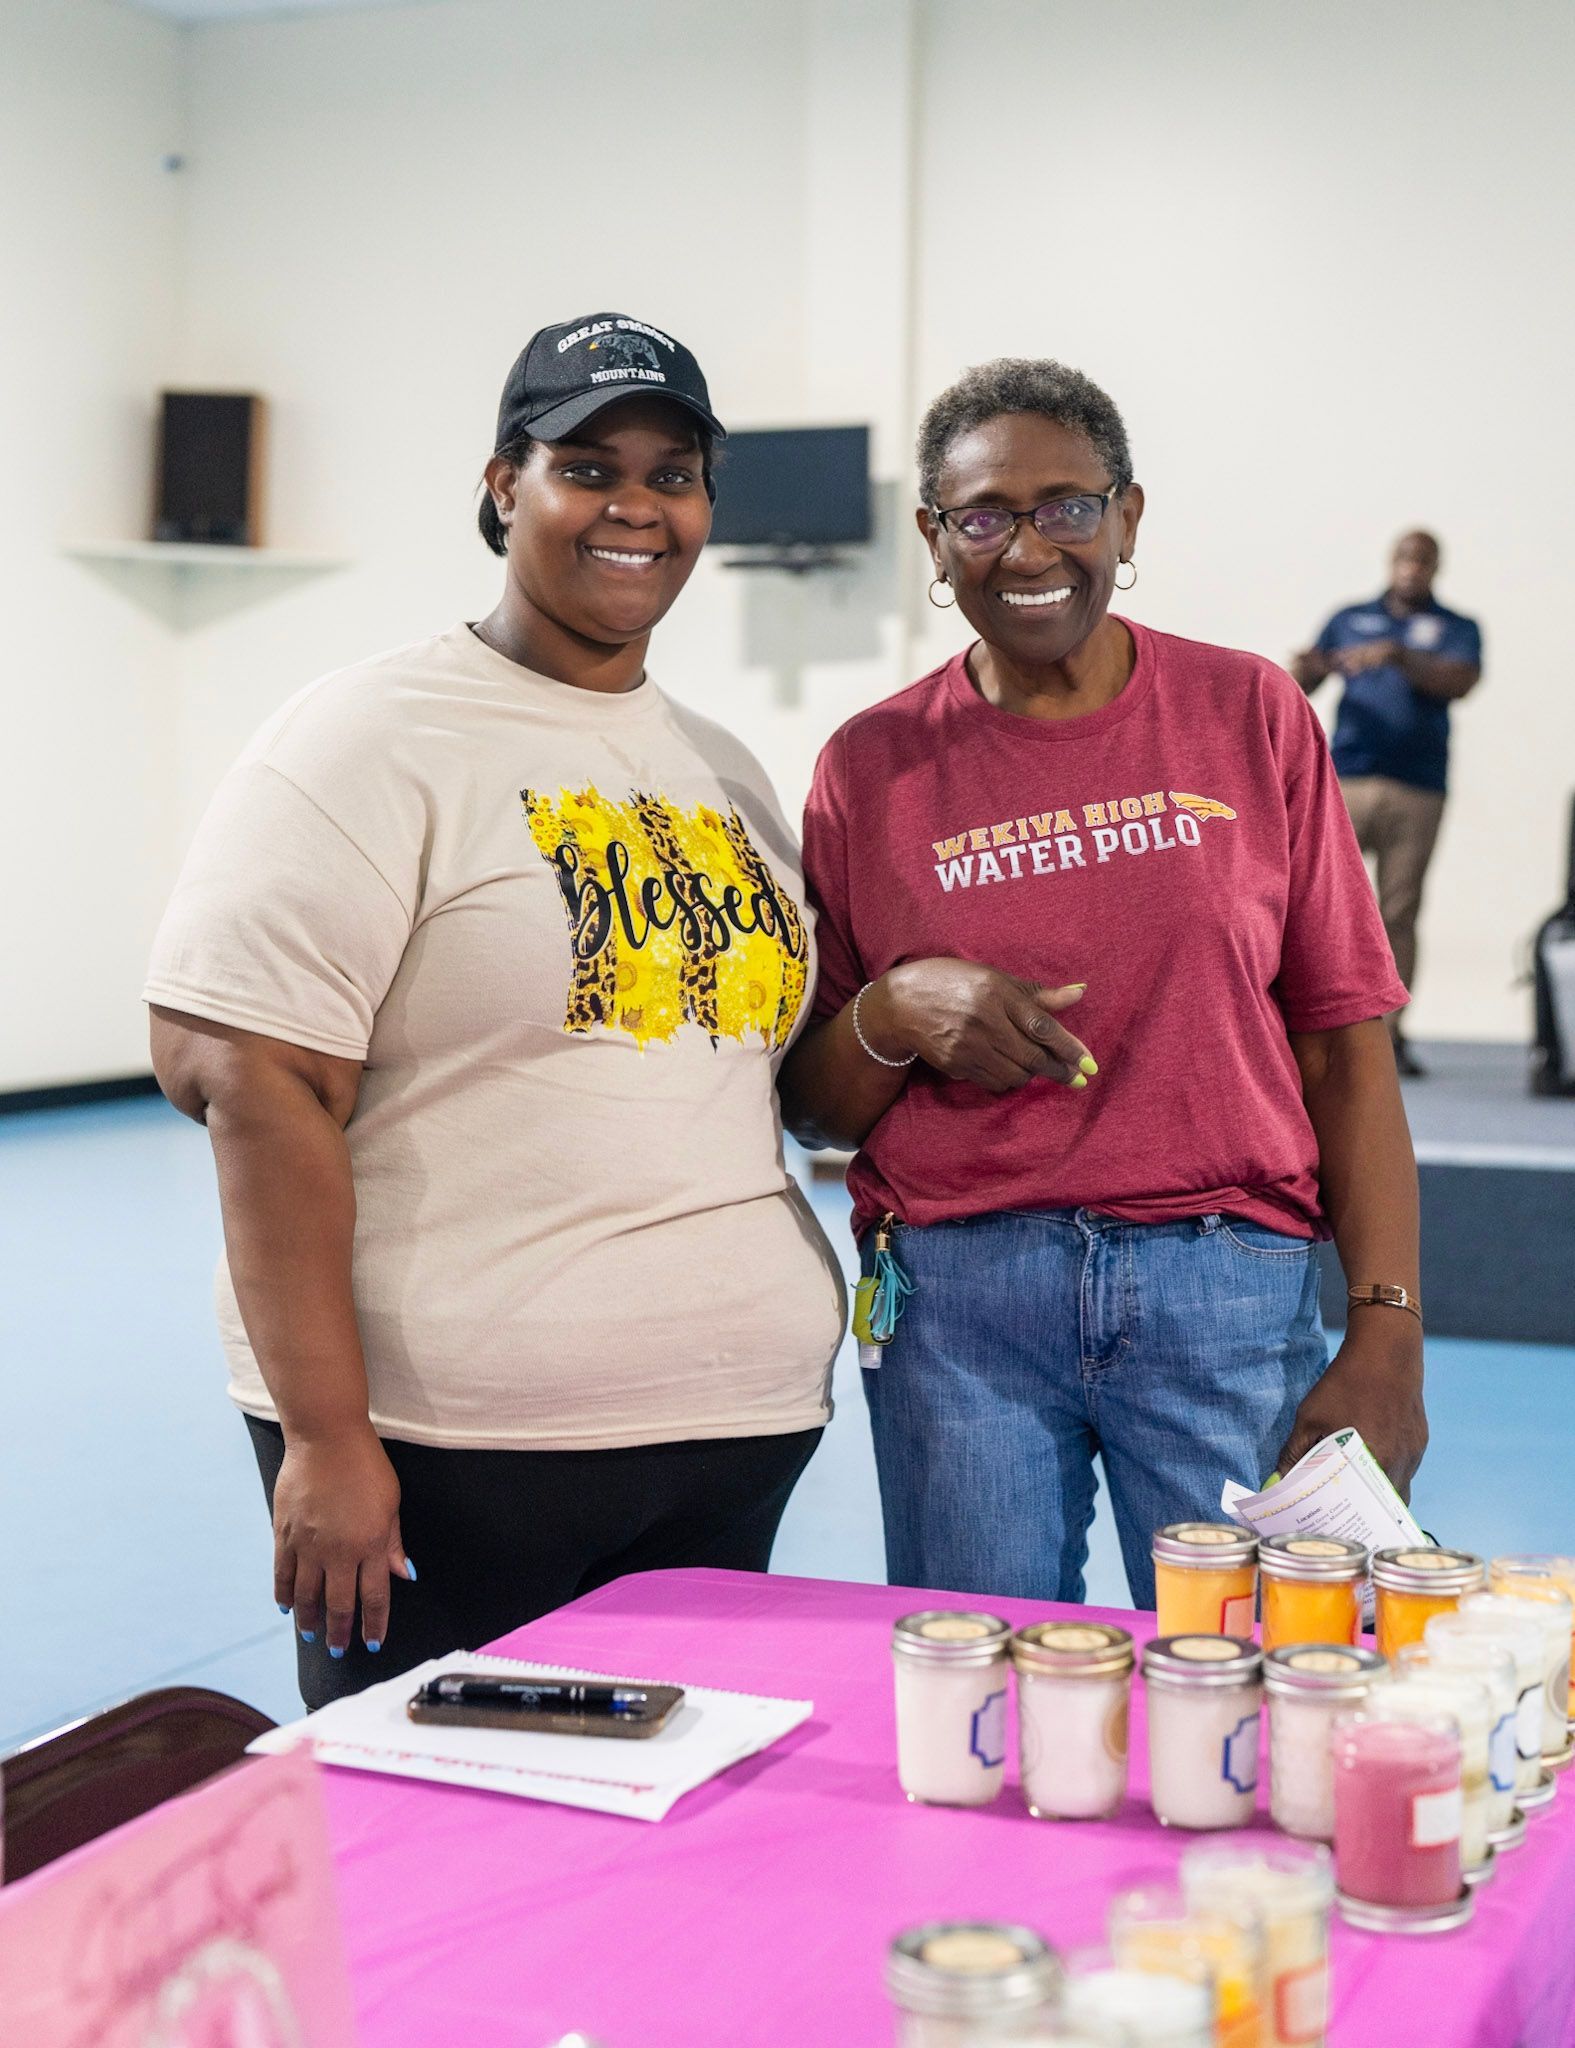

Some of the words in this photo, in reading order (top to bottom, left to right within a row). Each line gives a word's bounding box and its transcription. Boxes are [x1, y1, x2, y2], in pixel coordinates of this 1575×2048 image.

[557, 320, 613, 353] GREAT
[616, 319, 675, 352] SMOKY
[590, 368, 666, 384] MOUNTAINS
[932, 809, 1077, 861] WEKIVA
[1082, 791, 1168, 827] HIGH
[935, 834, 1086, 892] WATER
[1092, 814, 1201, 863] POLO
[555, 841, 802, 961] blessed
